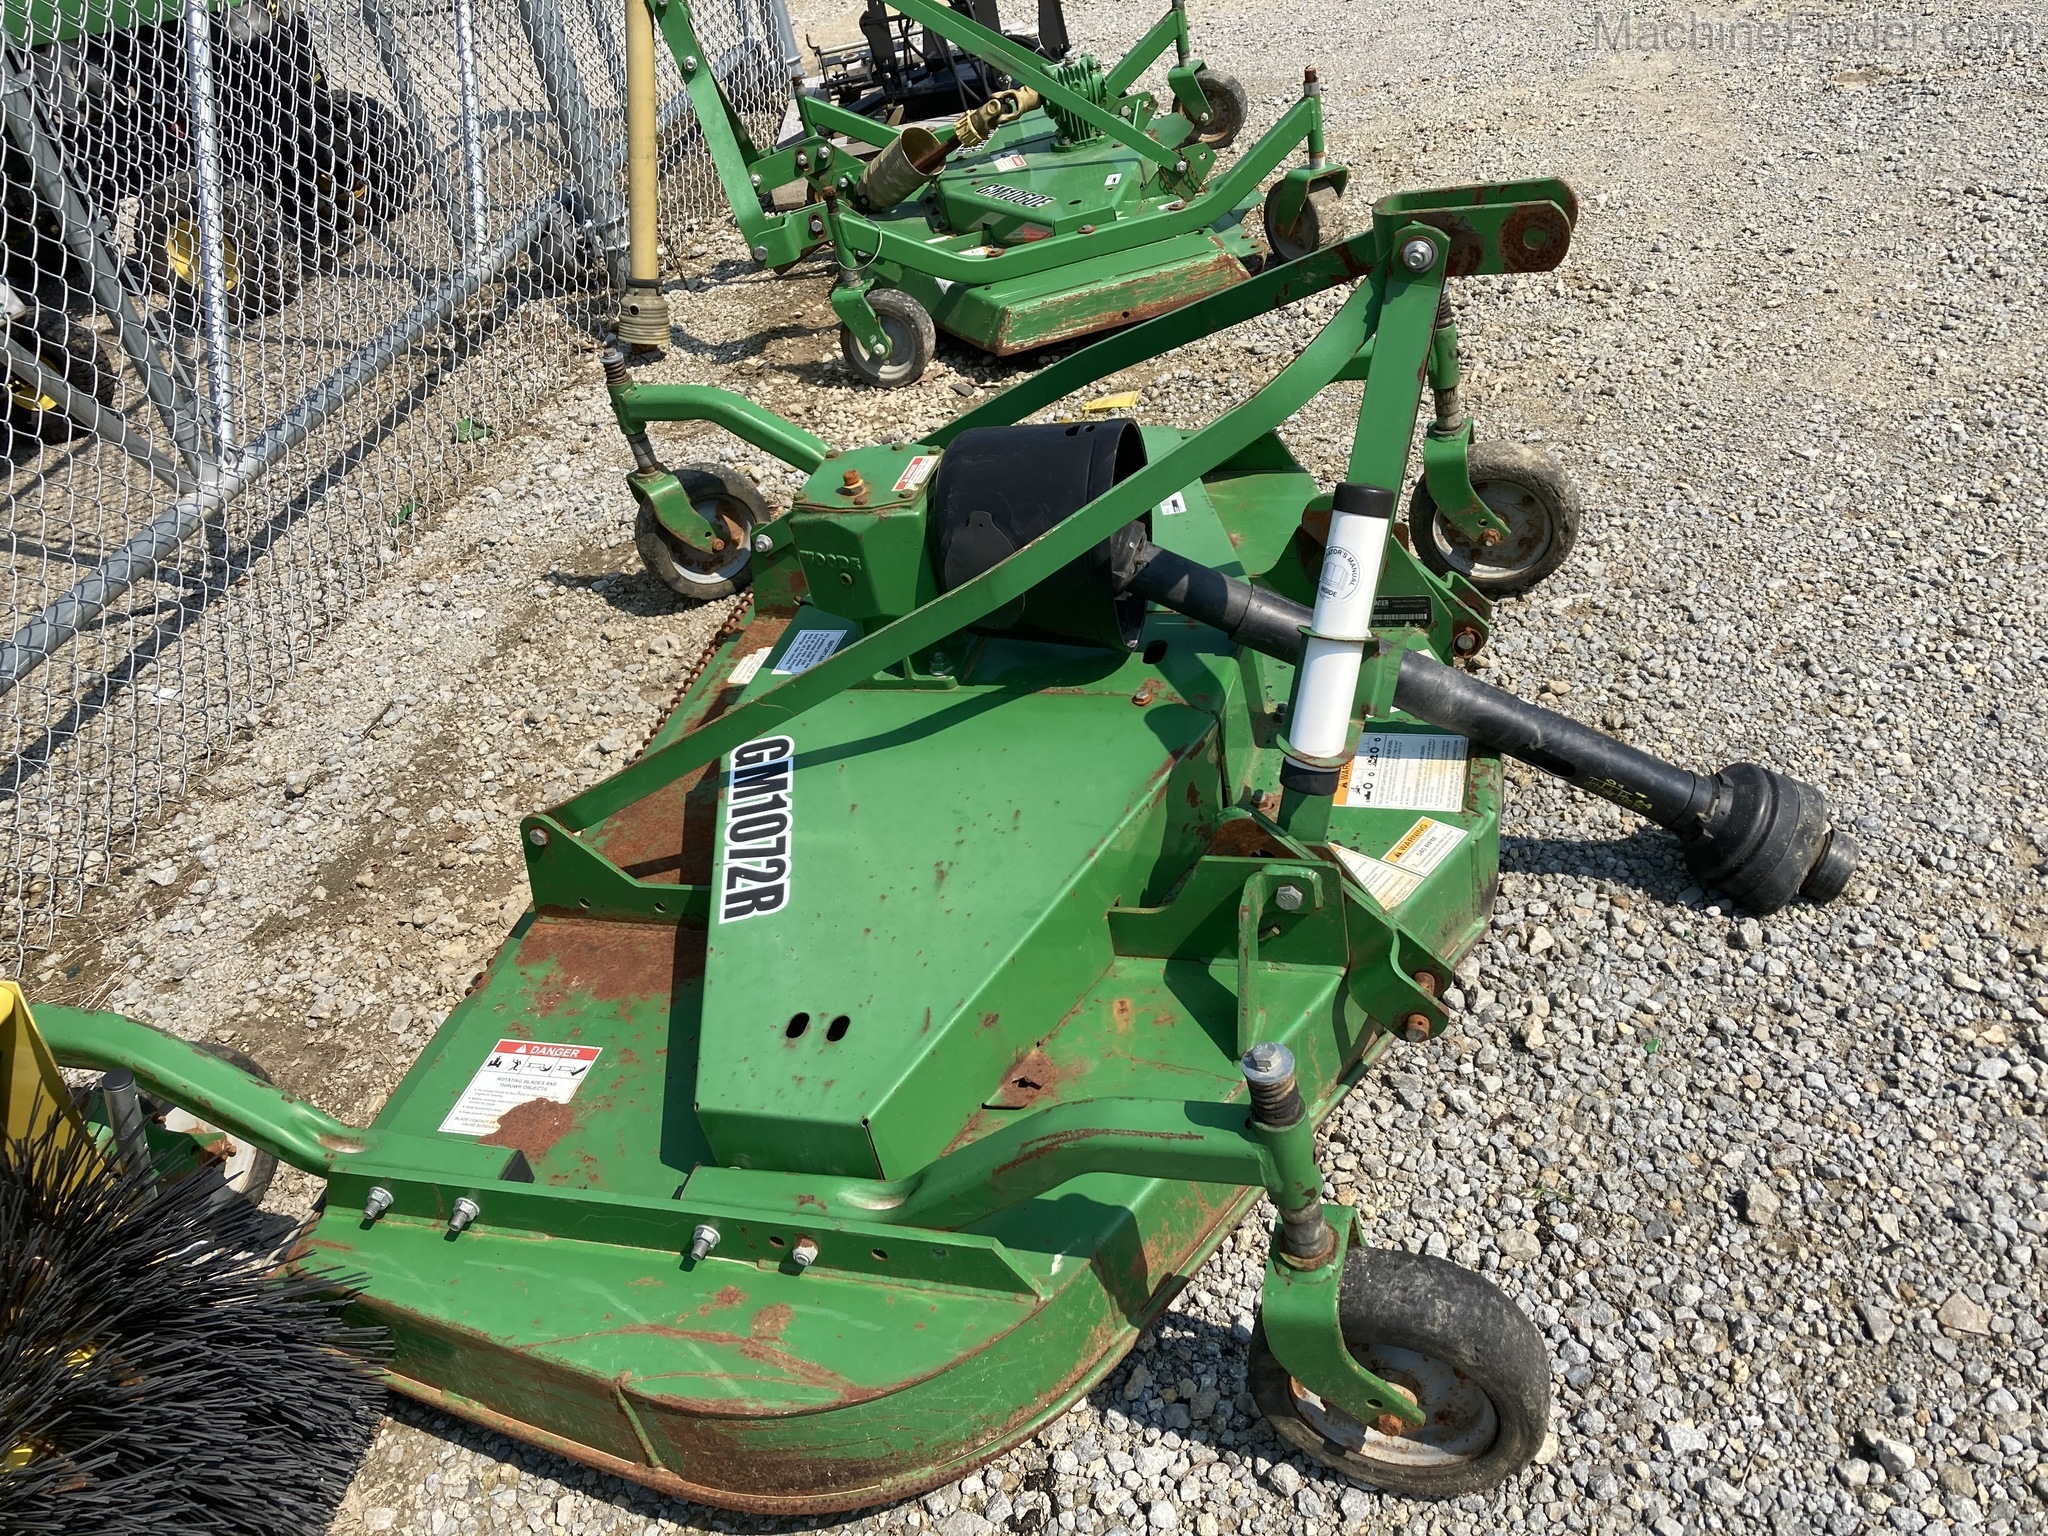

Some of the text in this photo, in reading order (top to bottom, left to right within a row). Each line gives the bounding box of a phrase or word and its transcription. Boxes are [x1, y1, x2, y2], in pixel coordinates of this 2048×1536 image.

[1347, 557, 1357, 586] MANUAL
[722, 736, 792, 921] GM1072R
[1399, 823, 1428, 851] WARNING
[529, 1045, 580, 1058] DANGER
[496, 1076, 523, 1084] ROTATING
